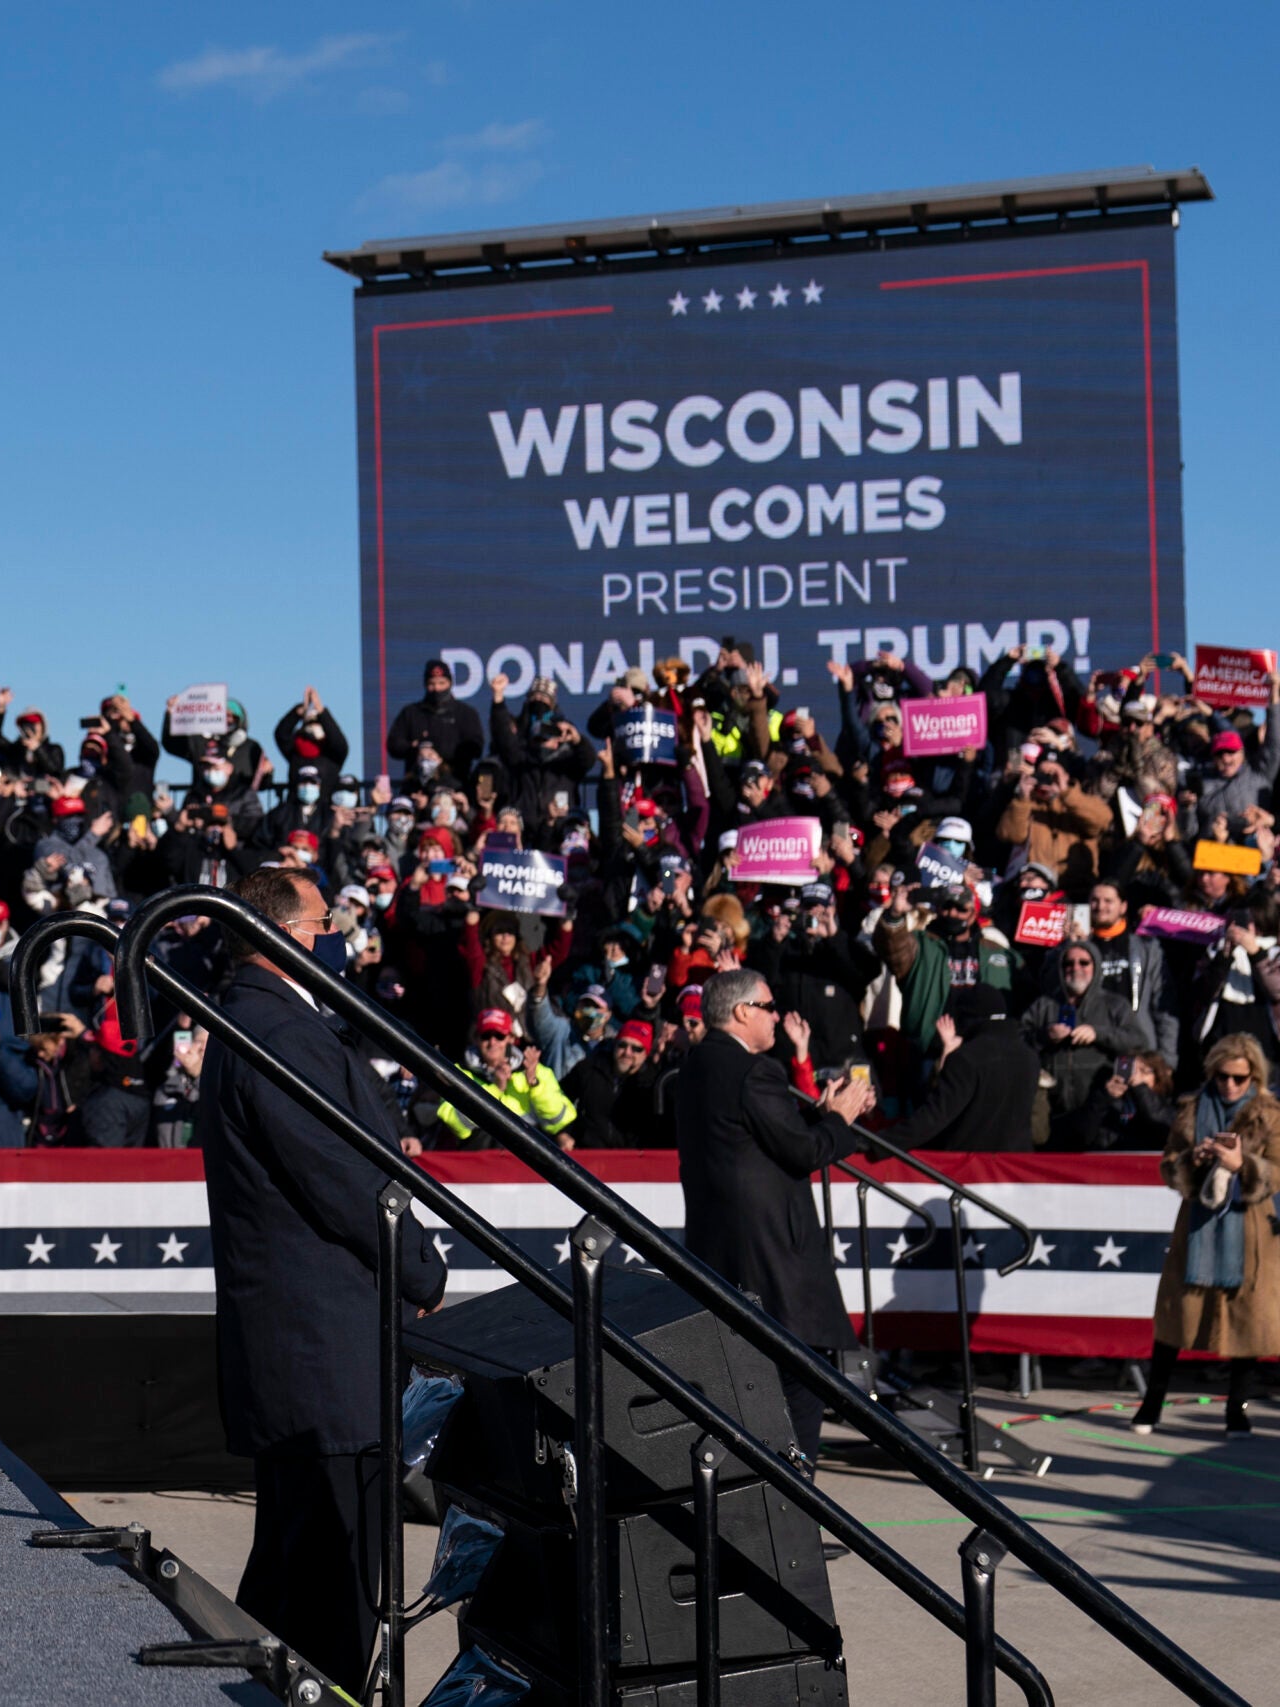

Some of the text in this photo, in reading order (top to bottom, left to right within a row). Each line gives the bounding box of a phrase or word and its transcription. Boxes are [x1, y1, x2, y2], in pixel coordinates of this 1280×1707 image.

[488, 371, 1023, 479] WISCONSIN
[563, 475, 947, 550] WELCOMES
[602, 557, 909, 617] PRESIDENT
[911, 713, 978, 733] Women
[743, 835, 809, 855] Women
[498, 879, 547, 899] MADE
